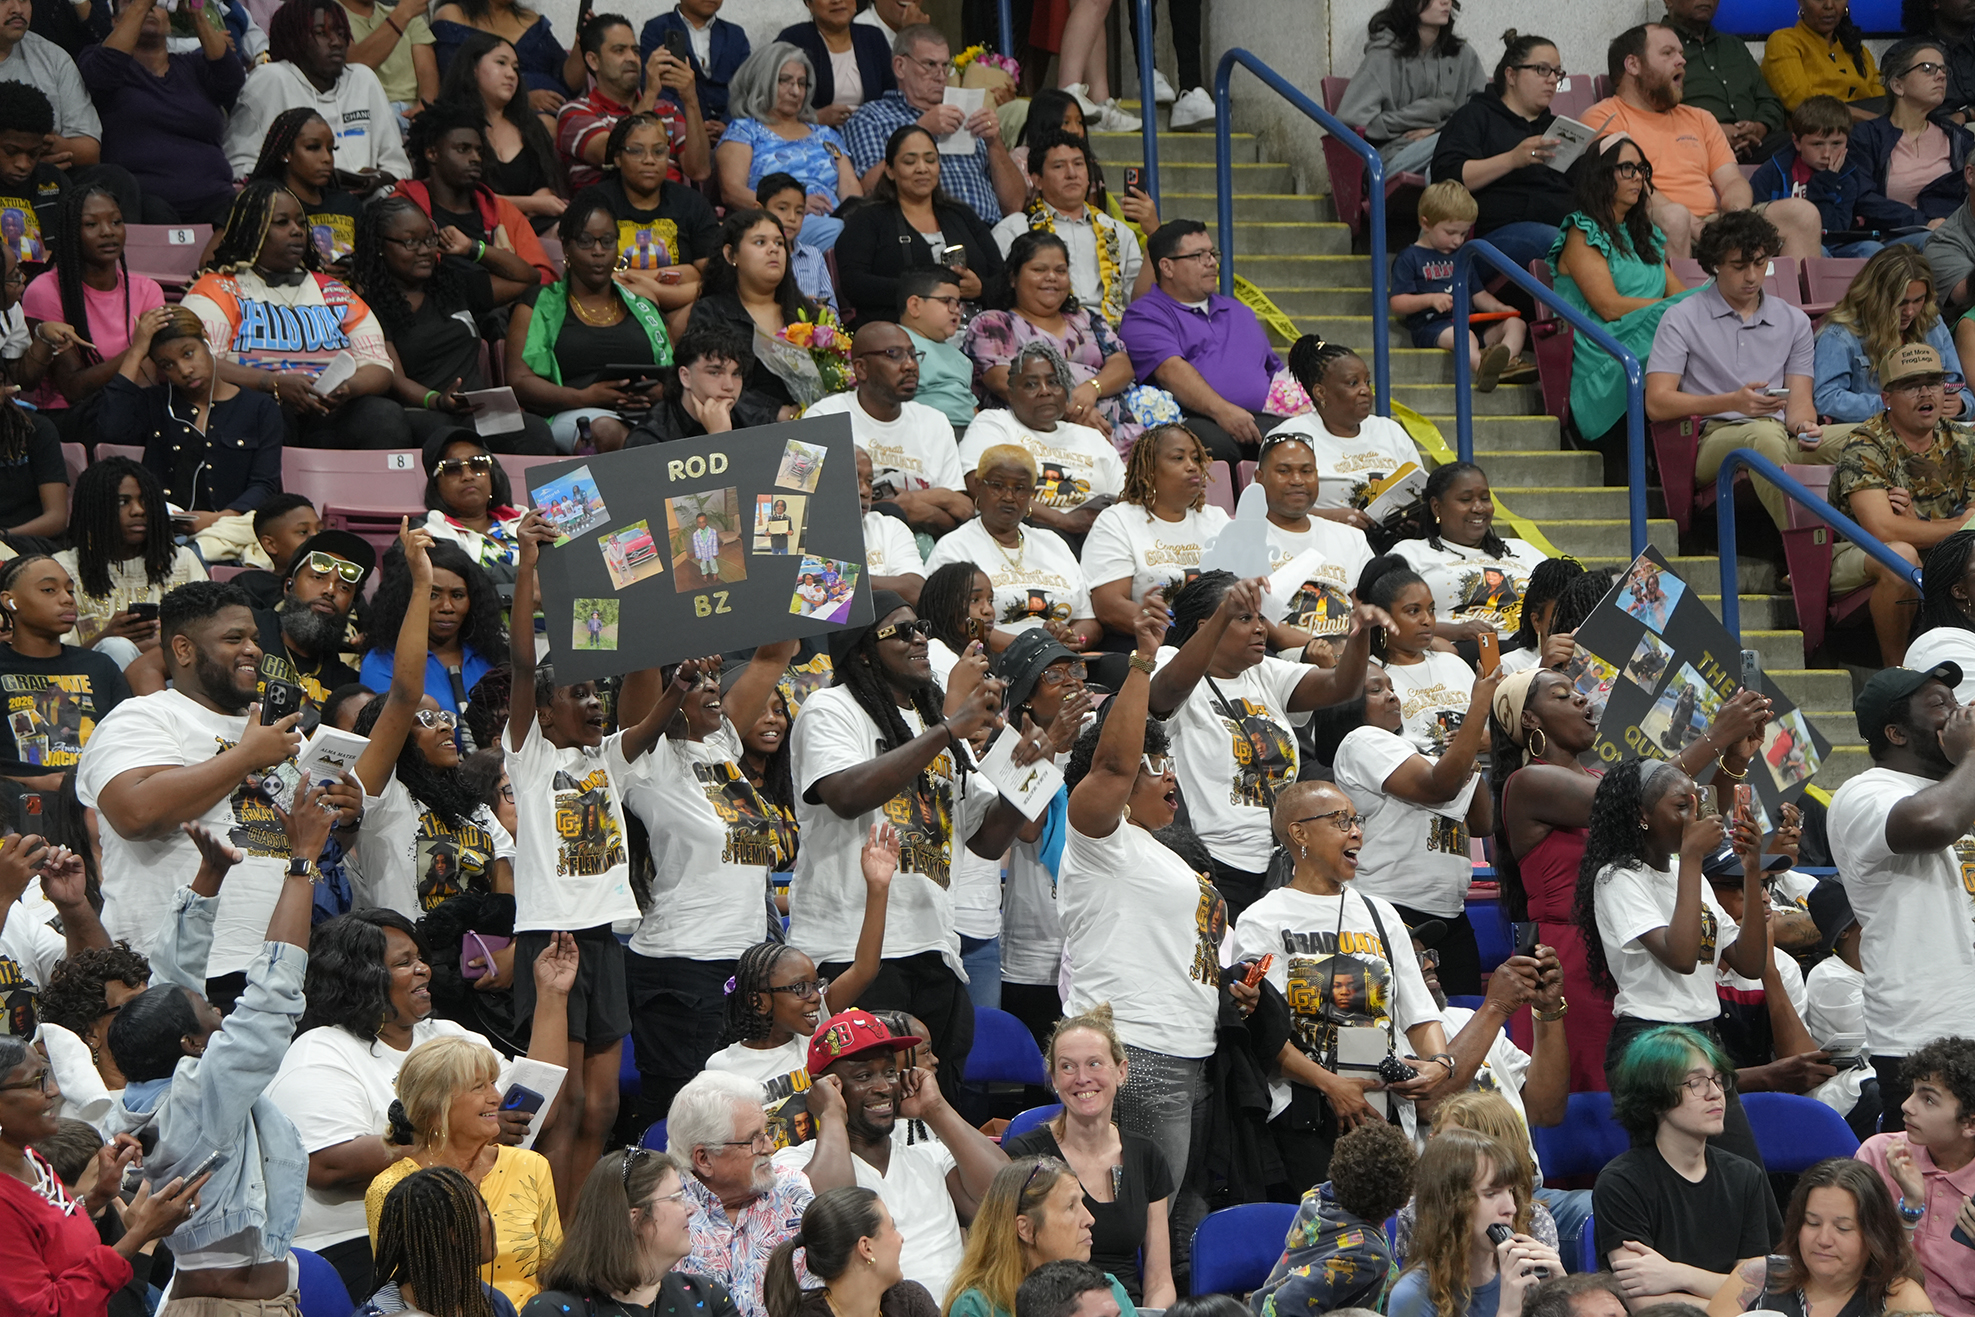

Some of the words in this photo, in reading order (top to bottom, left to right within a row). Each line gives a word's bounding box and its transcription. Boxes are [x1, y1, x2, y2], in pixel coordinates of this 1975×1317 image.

[178, 230, 185, 243] 8
[233, 297, 303, 352] HELLO
[1684, 421, 1688, 435] E
[397, 455, 404, 468] 8
[668, 452, 728, 482] ROD
[694, 591, 732, 618] BZ
[1697, 650, 1737, 699] THE
[8, 695, 34, 710] 2026
[320, 747, 337, 756] ALMA
[337, 750, 357, 760] MATER
[240, 802, 277, 822] ARNAY
[247, 826, 281, 848] CLASS
[247, 847, 270, 858] Goose
[270, 848, 290, 860] Creek
[568, 846, 628, 877] FLEMING
[1281, 928, 1387, 960] GRADUATE
